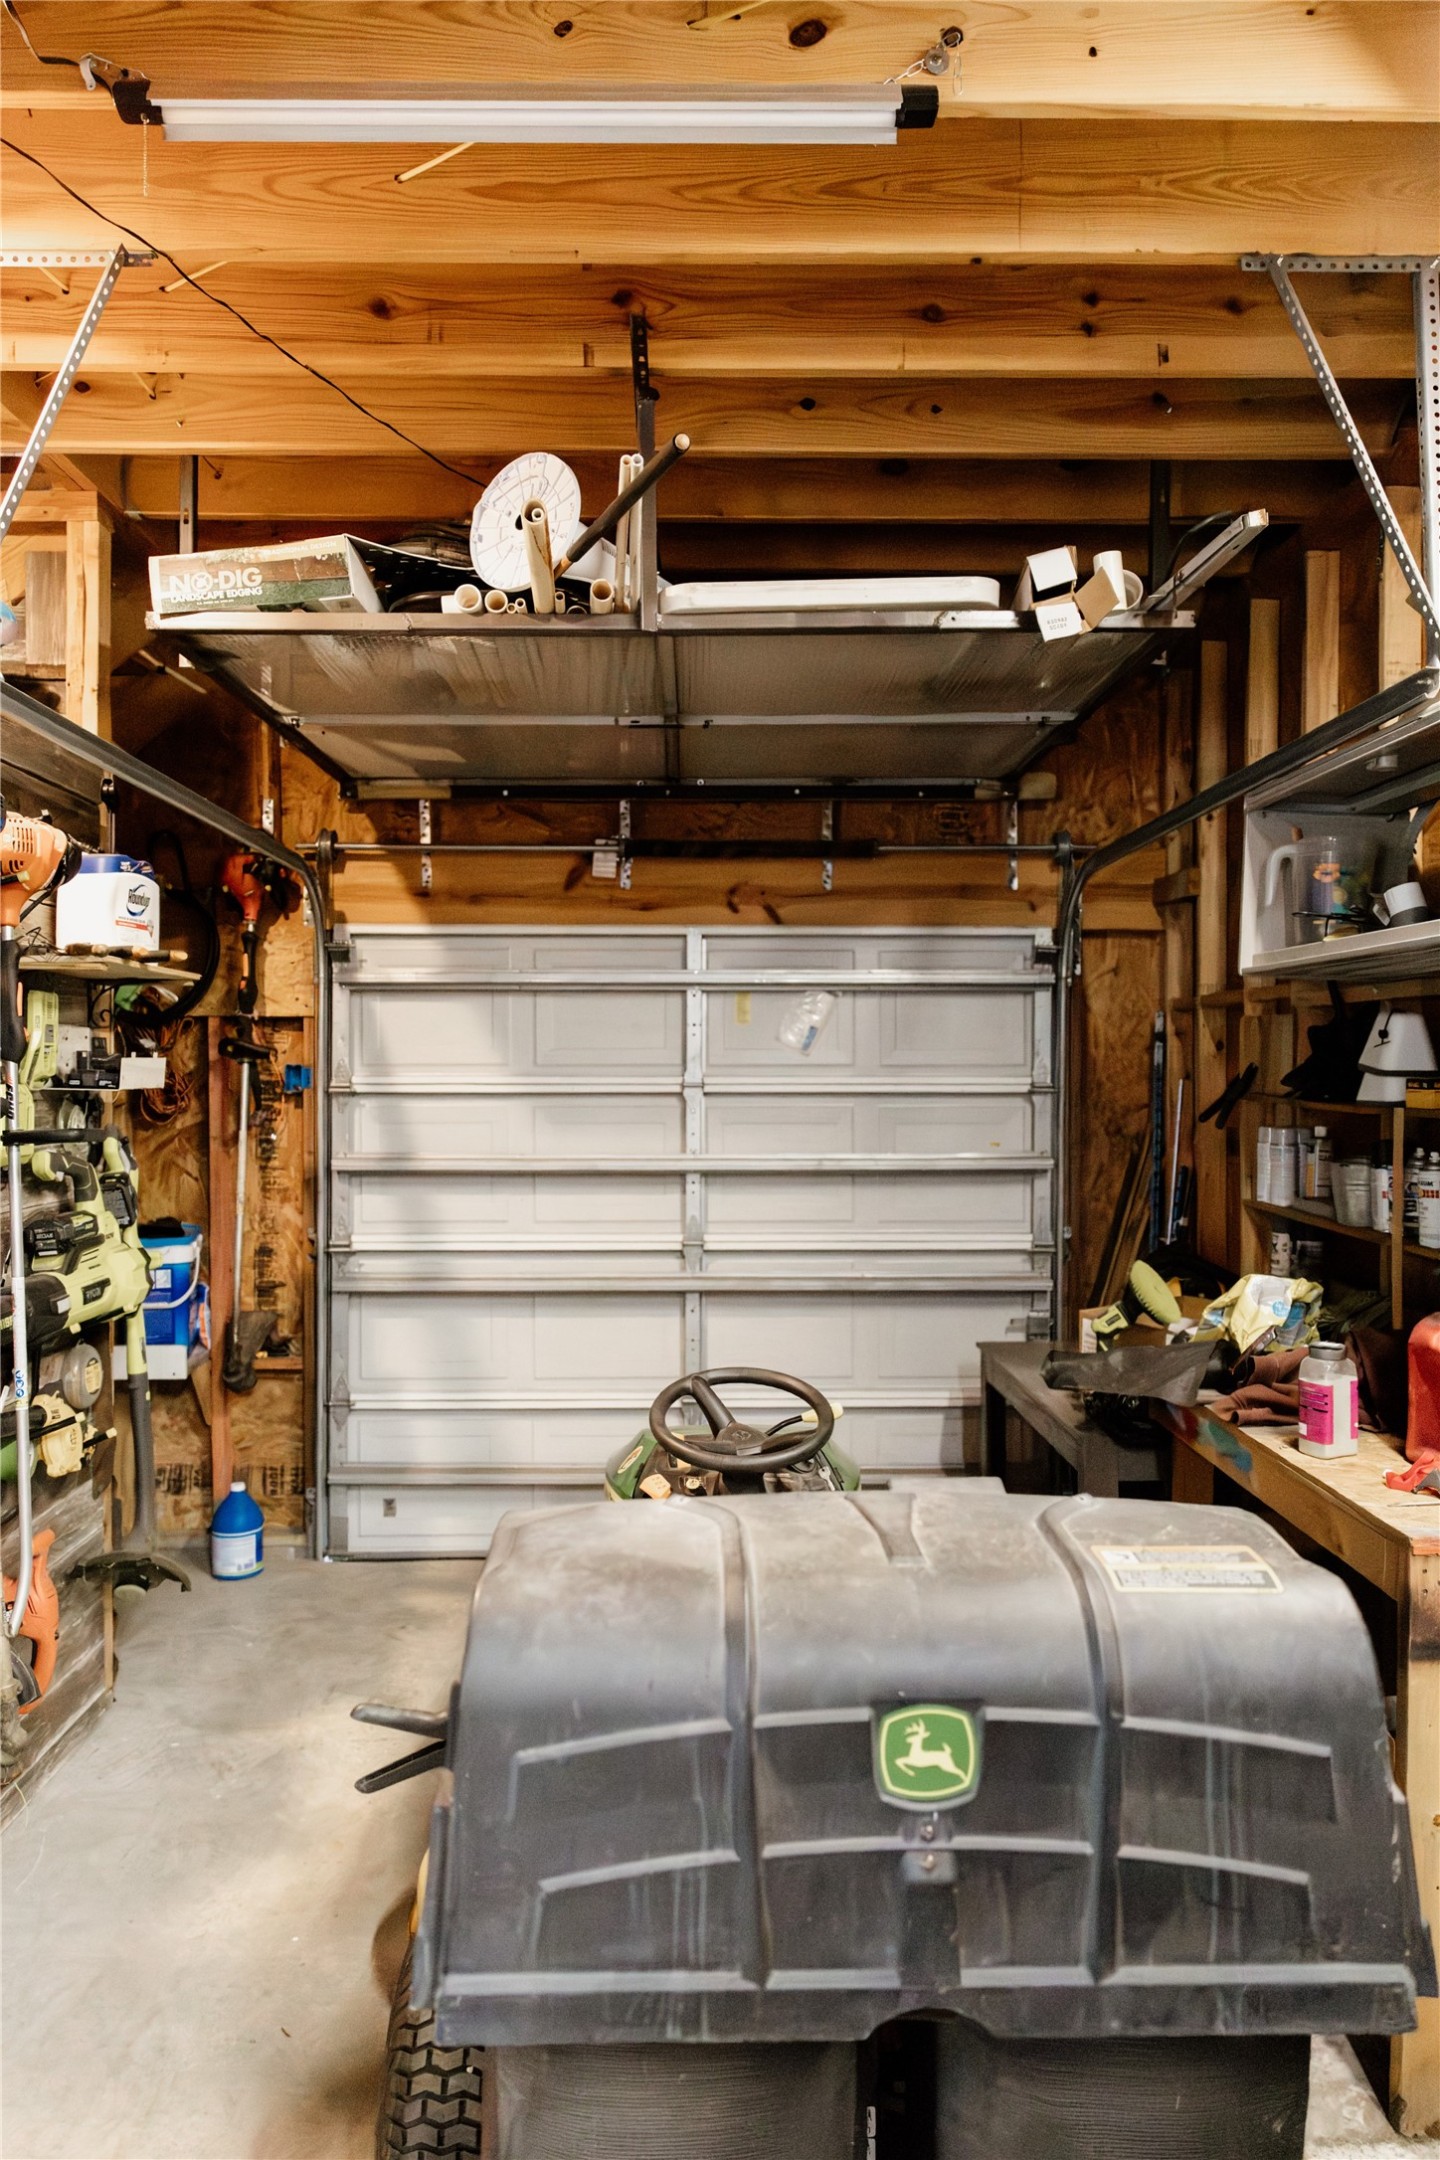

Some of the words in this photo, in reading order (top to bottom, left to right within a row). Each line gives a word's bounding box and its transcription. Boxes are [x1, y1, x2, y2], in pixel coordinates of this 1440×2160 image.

[310, 541, 337, 551] DESIGN
[169, 567, 262, 592] NO-DIG
[170, 590, 225, 603] LANDSCAPE
[226, 586, 262, 598] EDGING
